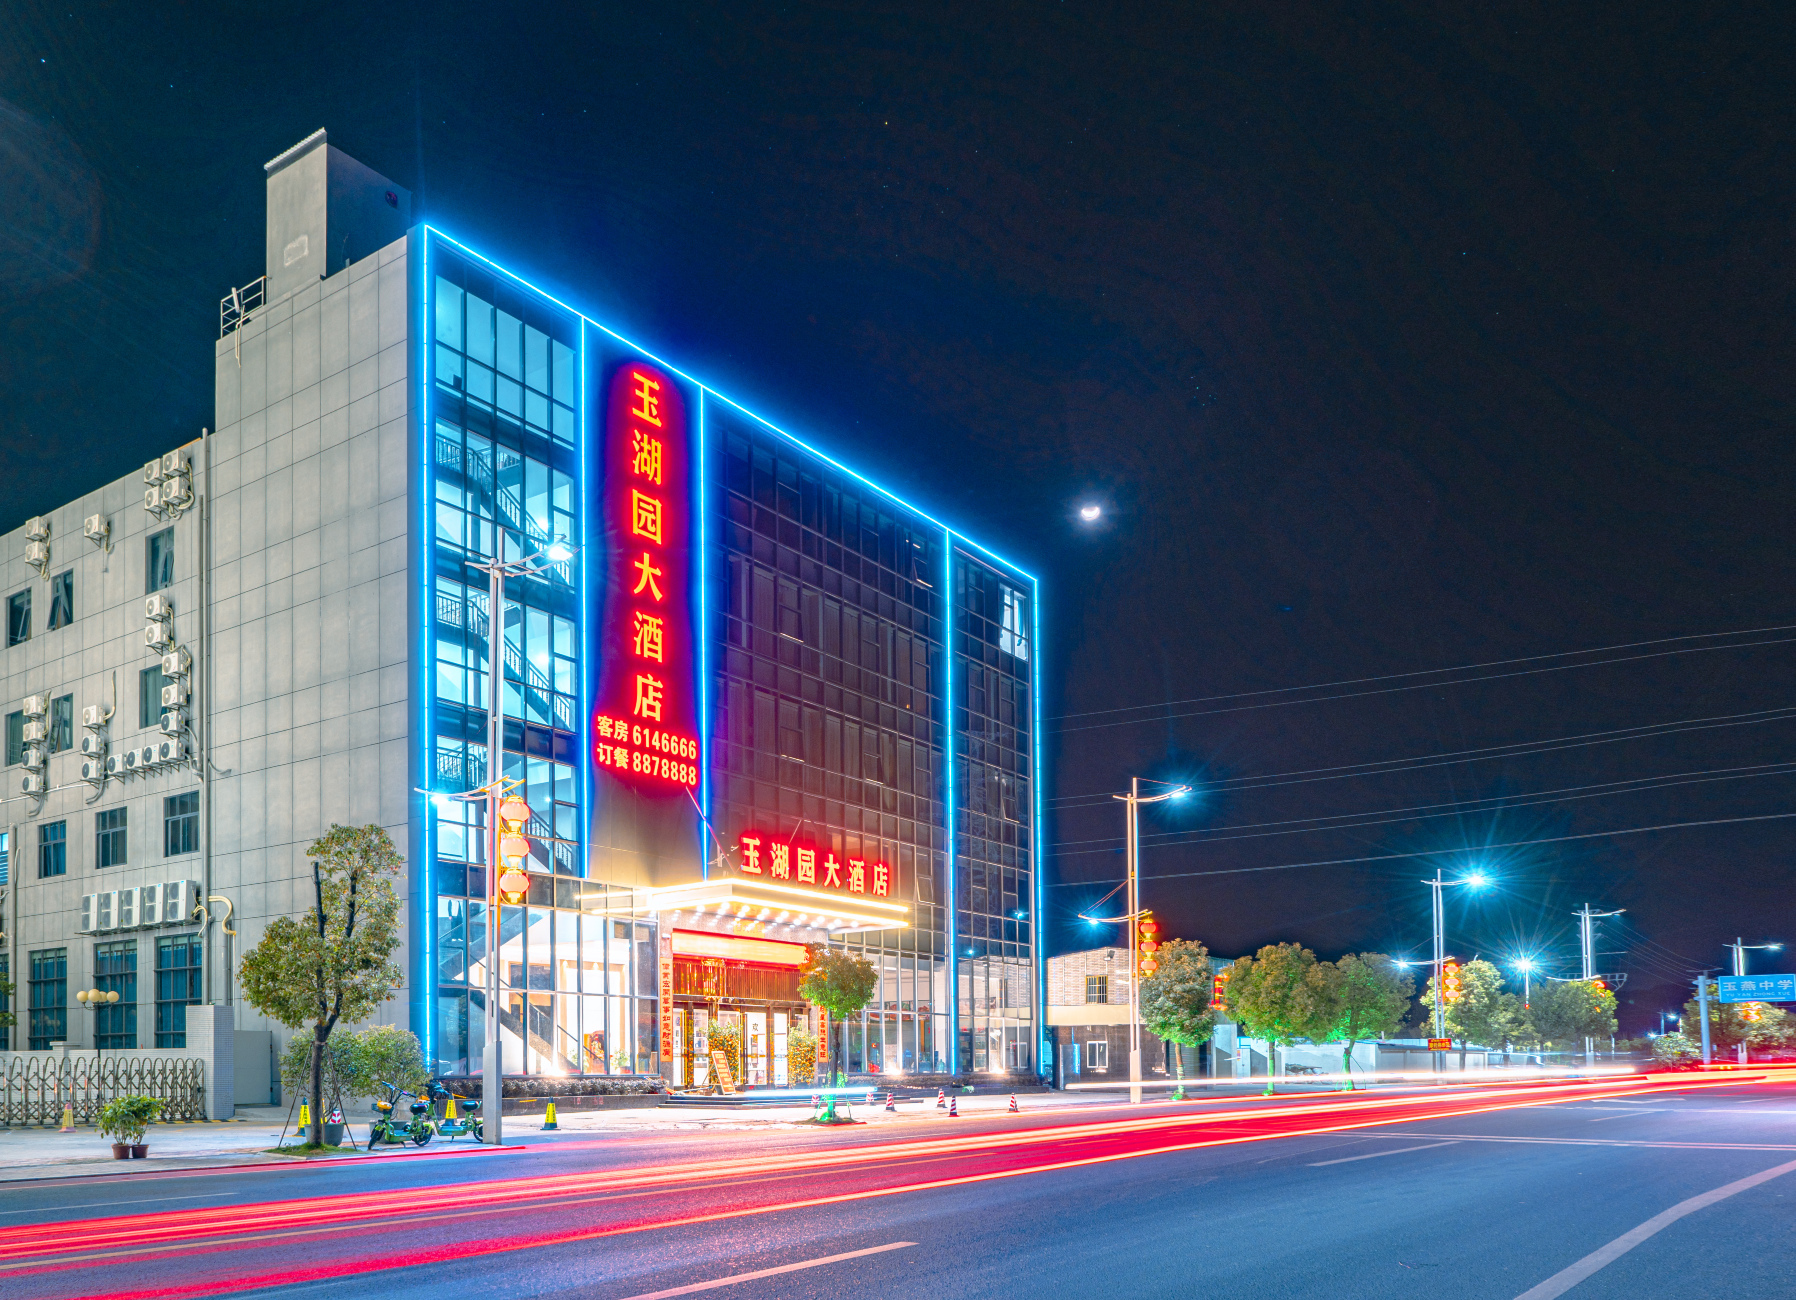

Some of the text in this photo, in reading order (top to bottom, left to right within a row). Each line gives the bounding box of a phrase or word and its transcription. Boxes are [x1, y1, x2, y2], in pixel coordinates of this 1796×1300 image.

[632, 371, 663, 722] 玉湖园大酒店
[597, 715, 697, 760] 客房 6146666
[597, 742, 697, 786] 订餐 8878888
[741, 836, 889, 897] 玉湖园大酒店
[1723, 980, 1793, 991] 玉燕中学
